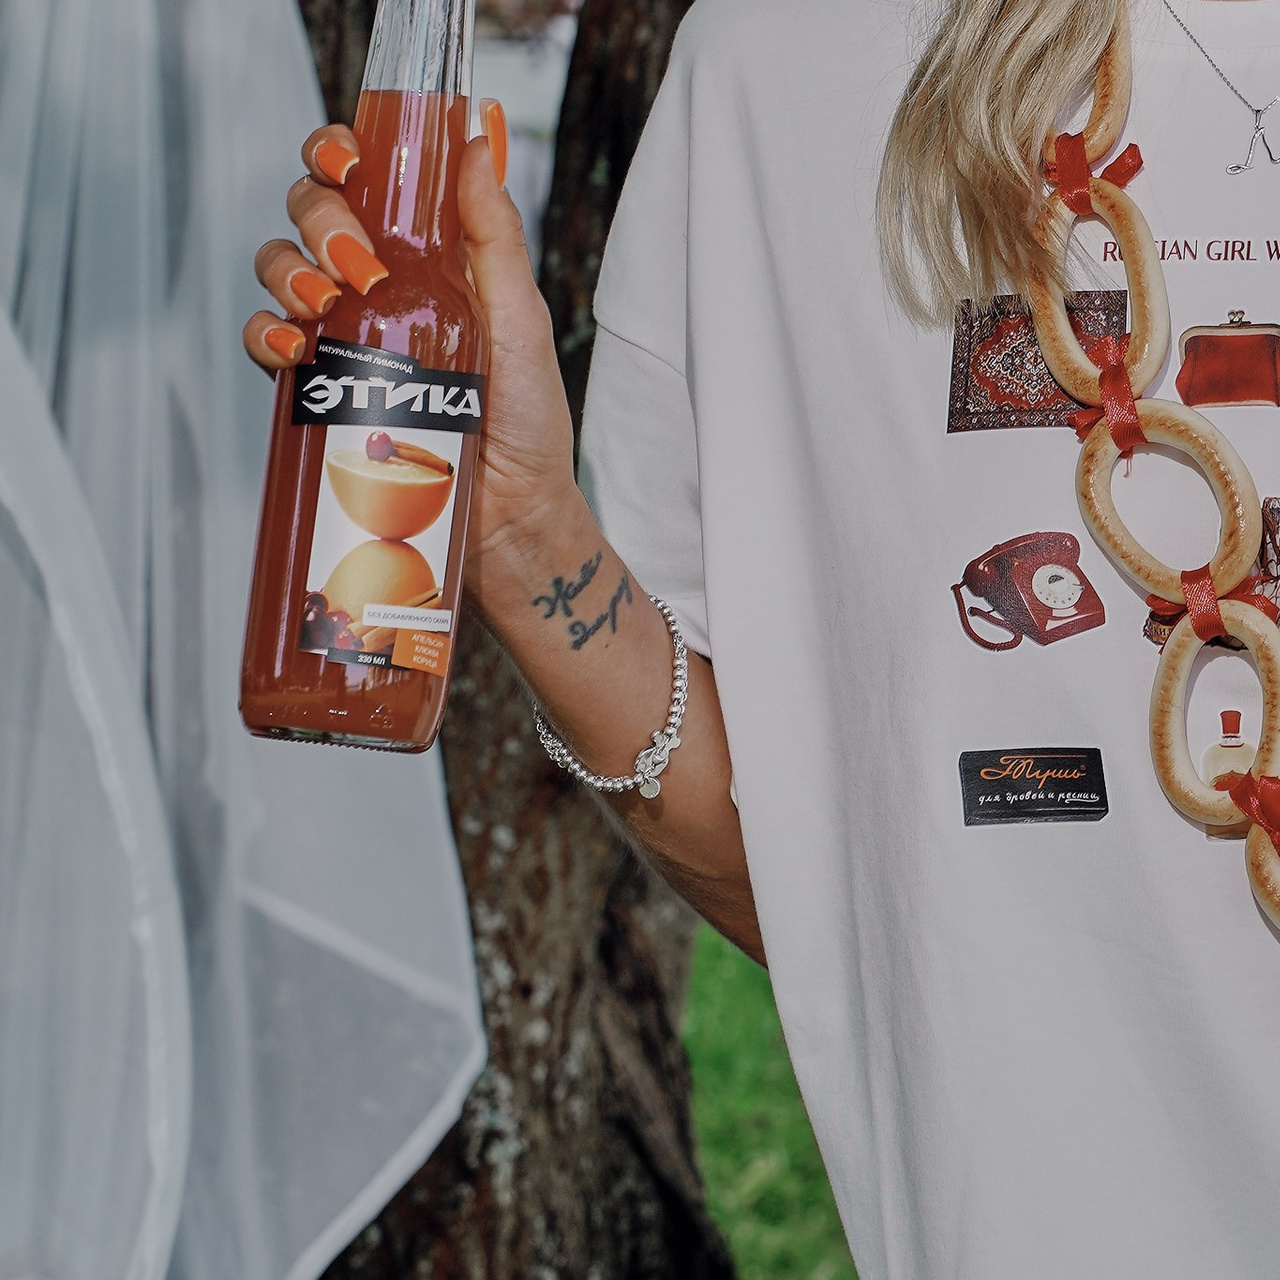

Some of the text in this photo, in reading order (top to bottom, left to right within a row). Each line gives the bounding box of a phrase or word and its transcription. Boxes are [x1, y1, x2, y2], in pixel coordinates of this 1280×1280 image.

[1102, 239, 1198, 262] RIAN
[1206, 239, 1257, 261] GIRL
[318, 344, 413, 374] НАТУРАЛЬНЫЙ ЛИМОНАД
[302, 374, 481, 418] ЭТИКА
[357, 654, 386, 666] 330 МЛ
[978, 795, 1001, 806] для
[1047, 792, 1055, 800] и
